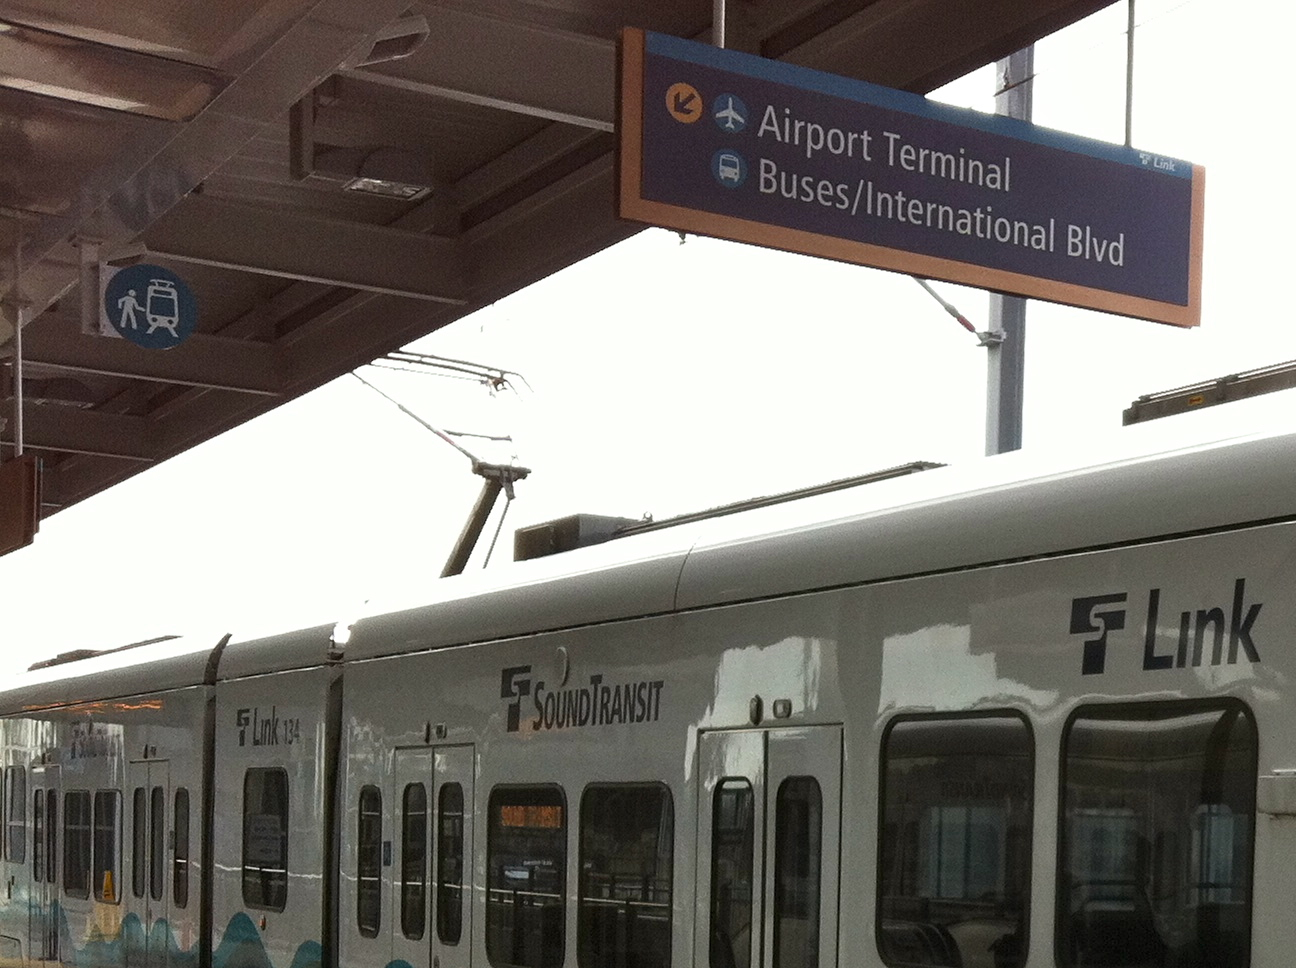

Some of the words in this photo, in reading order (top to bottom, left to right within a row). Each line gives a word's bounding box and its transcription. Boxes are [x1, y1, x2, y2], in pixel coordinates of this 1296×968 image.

[757, 106, 873, 159] Airport
[882, 130, 1011, 192] Terminal
[1153, 157, 1176, 172] Link
[757, 158, 1055, 253] Buses/International
[1066, 225, 1125, 267] Blvd
[1142, 578, 1263, 671] Link
[252, 705, 279, 746] Link
